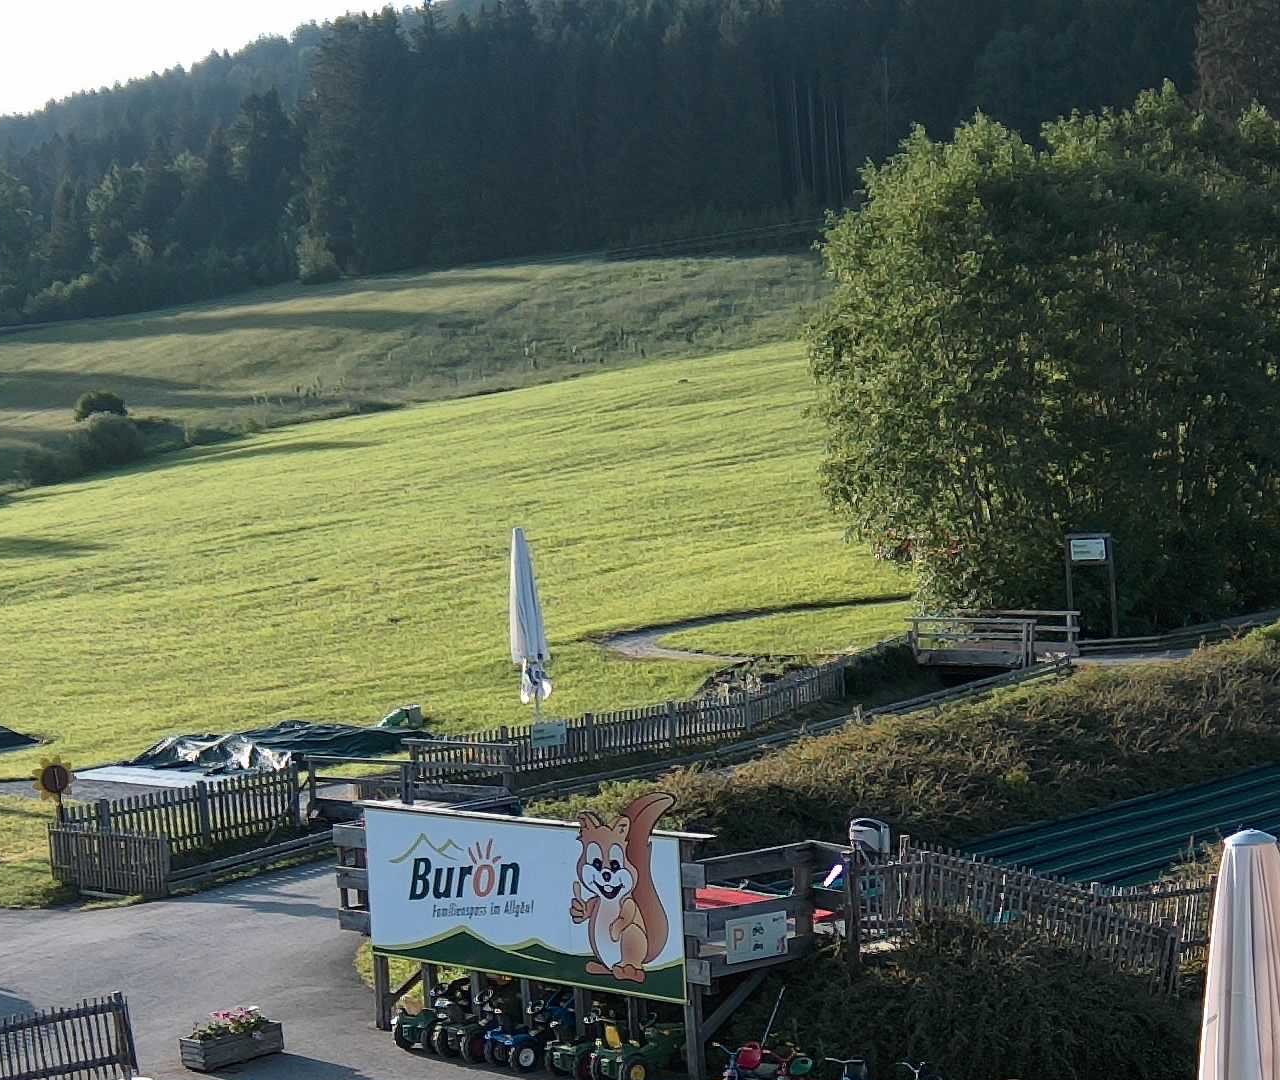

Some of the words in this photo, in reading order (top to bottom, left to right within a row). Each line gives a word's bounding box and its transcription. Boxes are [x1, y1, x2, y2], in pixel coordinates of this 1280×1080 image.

[409, 857, 520, 901] Buron
[490, 902, 501, 915] im
[733, 928, 745, 951] P
